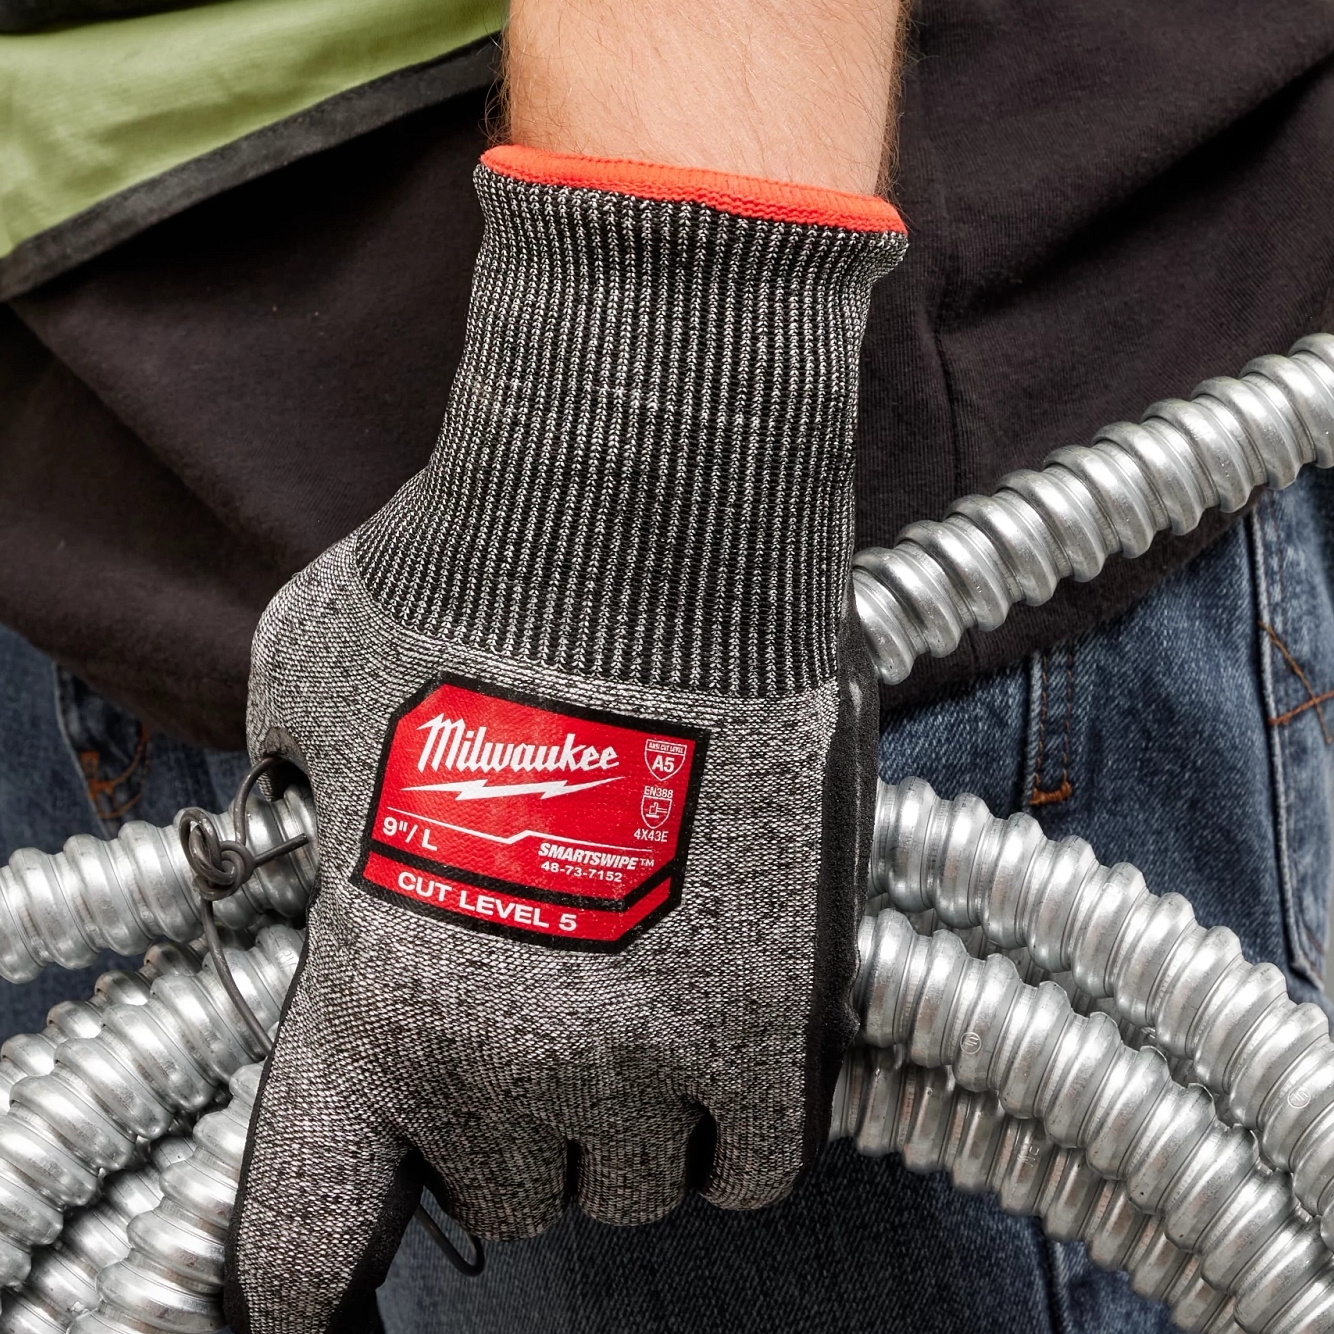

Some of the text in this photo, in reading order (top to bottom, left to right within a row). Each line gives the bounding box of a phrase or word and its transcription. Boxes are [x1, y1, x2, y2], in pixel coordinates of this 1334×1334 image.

[416, 712, 620, 774] Milwaukee
[648, 741, 684, 755] ANSI CUT LEVEL
[652, 755, 675, 773] A5
[644, 785, 674, 799] EN388
[633, 828, 669, 843] 4X43E
[541, 861, 623, 883] 48-73-7152
[398, 871, 578, 932] CUT LEVEL 5
